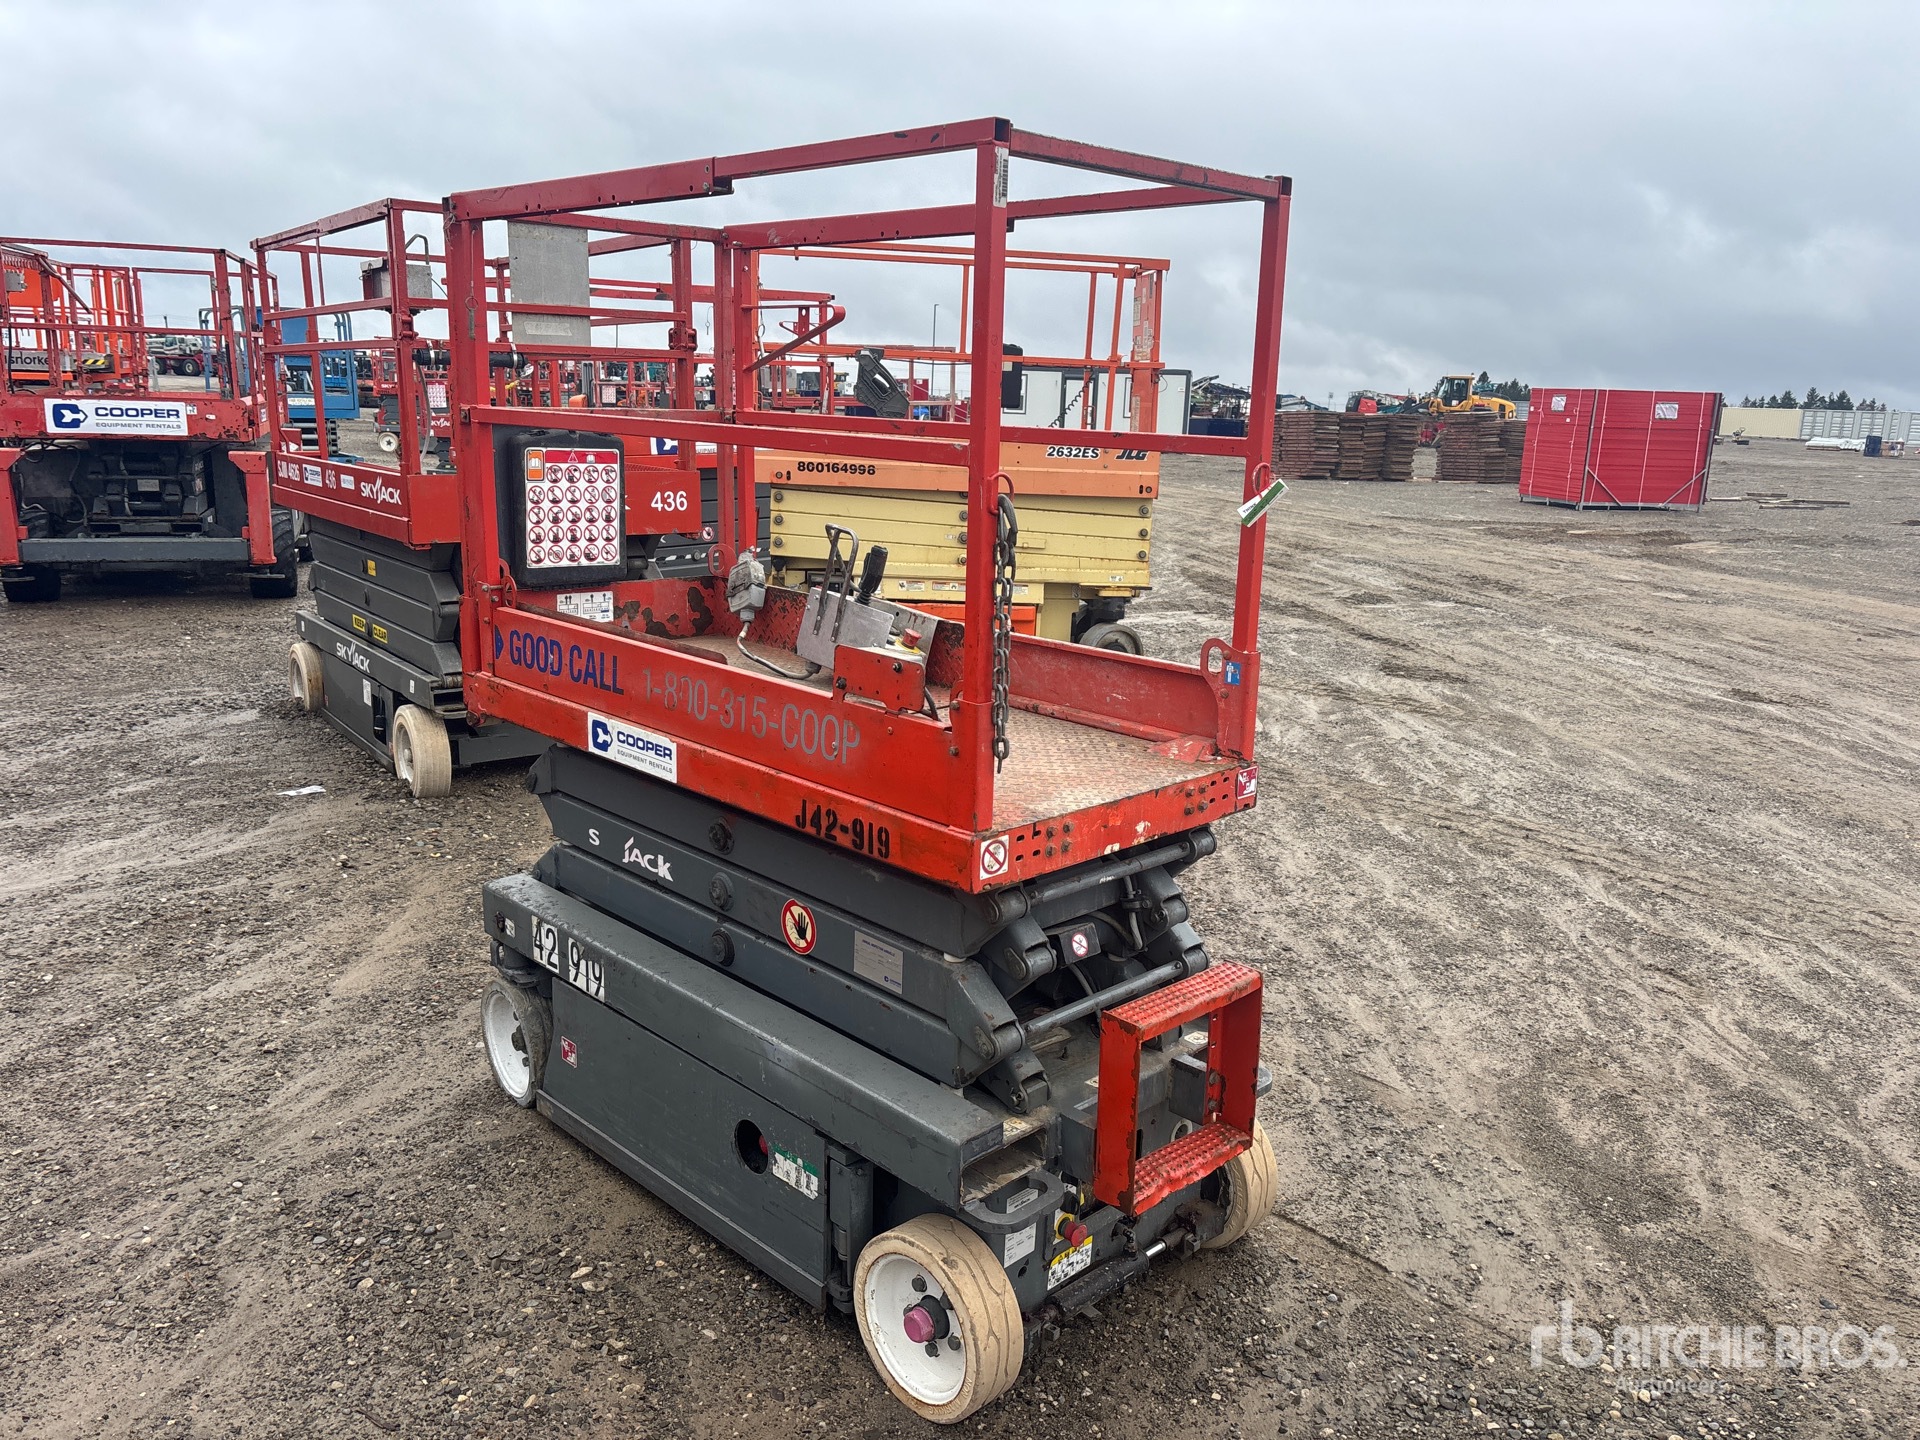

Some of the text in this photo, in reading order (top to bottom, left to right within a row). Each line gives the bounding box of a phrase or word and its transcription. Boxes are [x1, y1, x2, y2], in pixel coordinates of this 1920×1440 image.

[11, 351, 50, 365] snorke
[95, 407, 180, 418] COOPER
[1047, 446, 1100, 459] 2632ES
[1116, 449, 1149, 461] JLG
[325, 469, 336, 489] 436
[360, 475, 402, 505] SKYJACK
[651, 490, 688, 512] 436
[354, 617, 365, 629] KEEP
[336, 641, 370, 673] SKYJACK
[509, 629, 624, 695] GOOD CALL
[617, 730, 673, 760] COOPER
[617, 749, 673, 774] EQUIPMENT RENTALS
[795, 798, 890, 859] J42-919
[534, 920, 558, 970] 42
